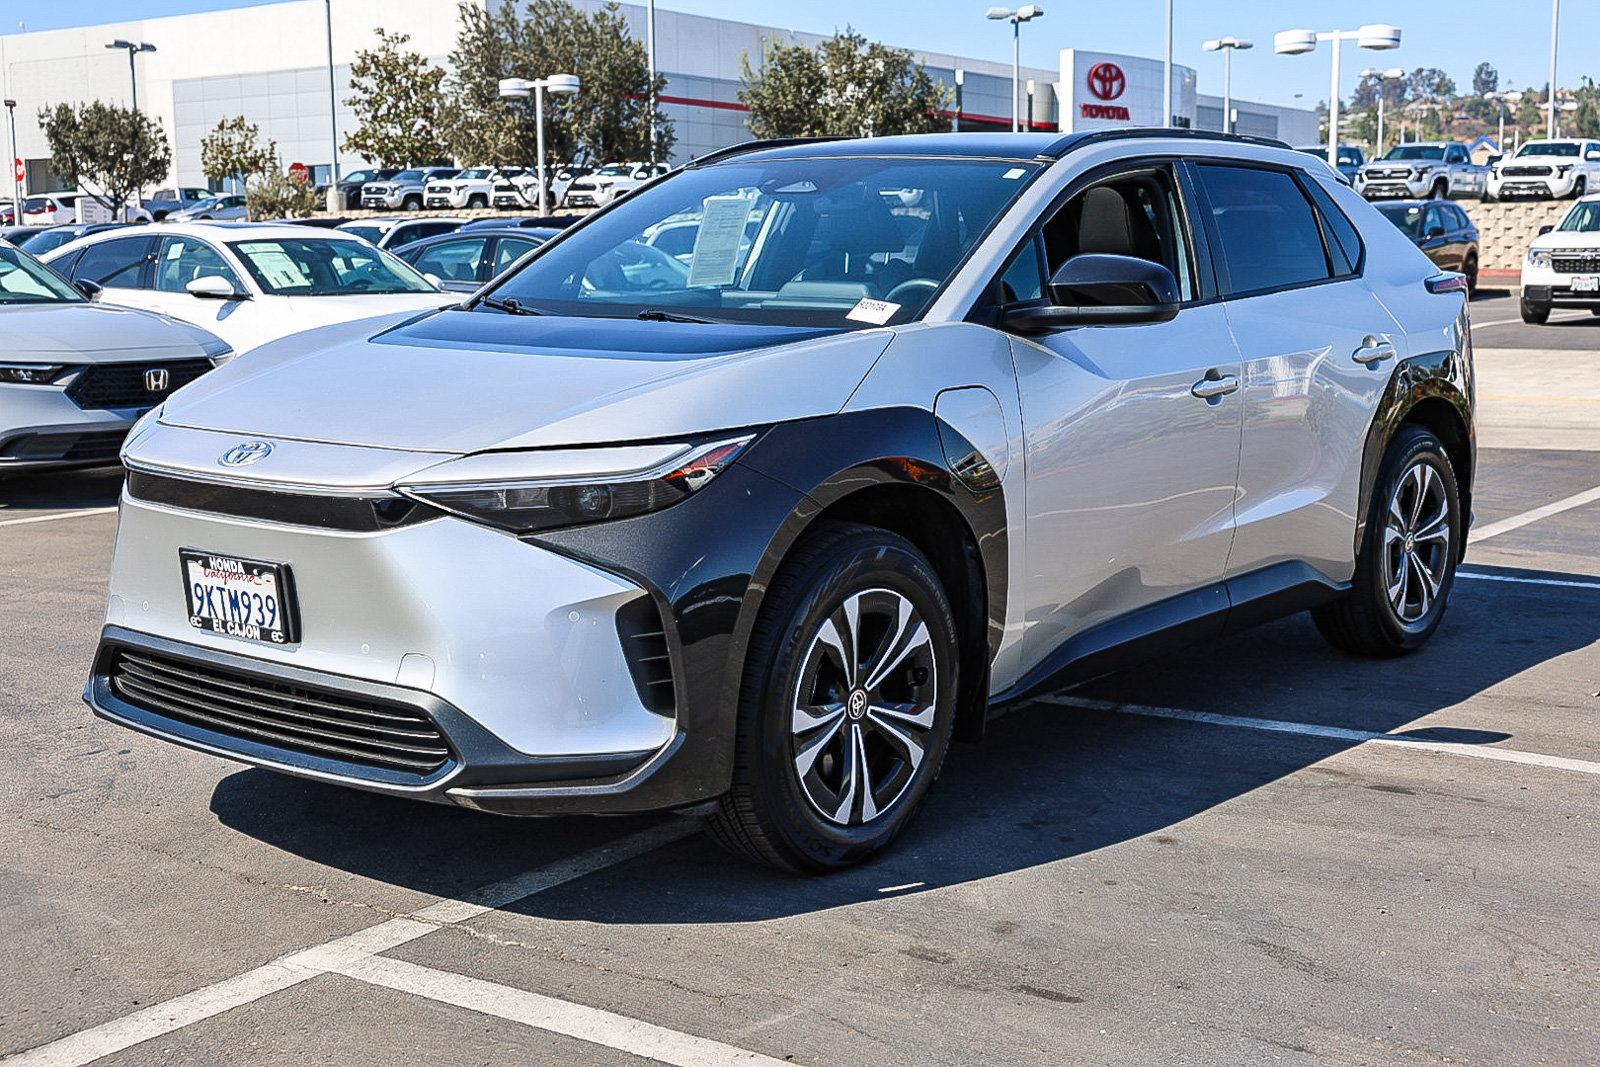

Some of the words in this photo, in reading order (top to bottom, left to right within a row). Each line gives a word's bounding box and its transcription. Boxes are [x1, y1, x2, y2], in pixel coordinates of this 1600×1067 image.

[1080, 103, 1130, 121] TOYOTA
[209, 557, 246, 575] HONDA
[194, 582, 277, 628] 9KTM939
[212, 619, 226, 633] EL
[226, 621, 261, 641] CAJON
